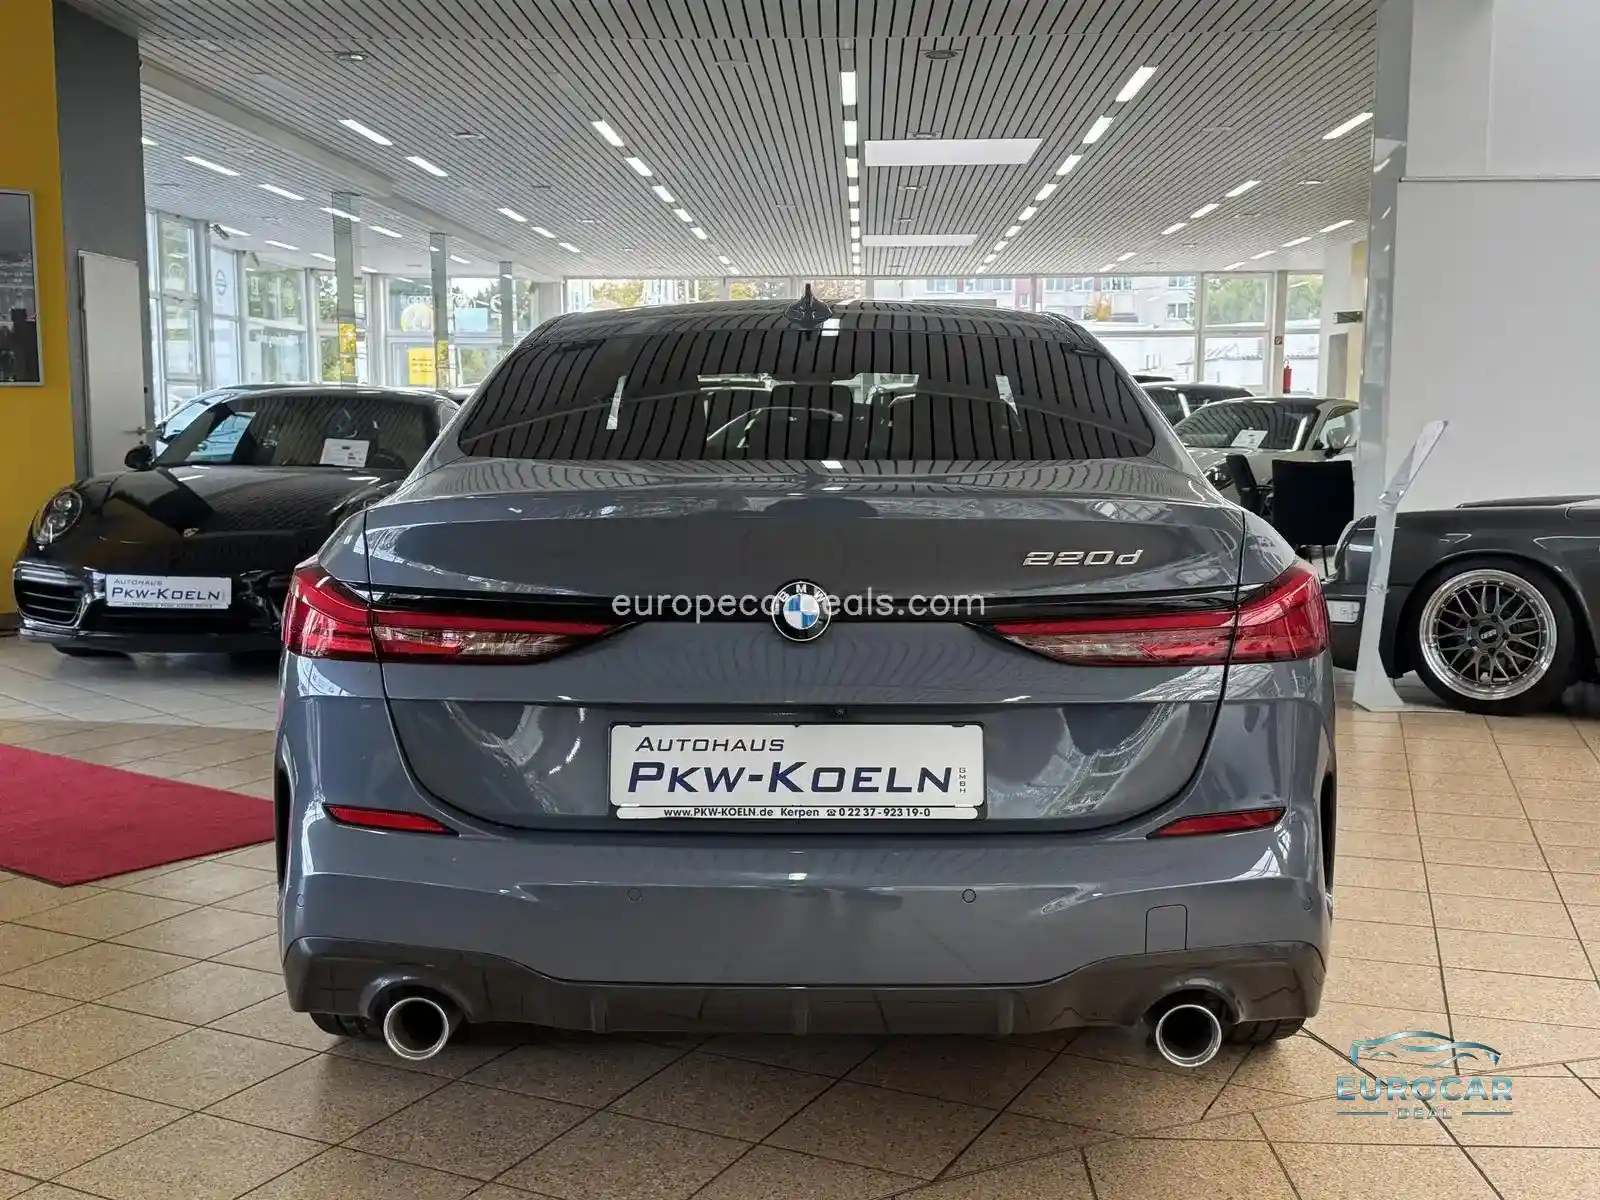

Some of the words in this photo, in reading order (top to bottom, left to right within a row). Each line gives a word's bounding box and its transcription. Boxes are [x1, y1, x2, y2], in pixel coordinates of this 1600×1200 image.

[1022, 549, 1144, 566] 220d
[111, 587, 220, 601] PKW-KOELN
[779, 584, 826, 603] BMW
[635, 737, 785, 752] AUTOHAUS
[628, 762, 952, 793] PKW-KOELN
[664, 807, 773, 817] www.PKW-KOELN.de
[781, 807, 819, 818] Kerpen
